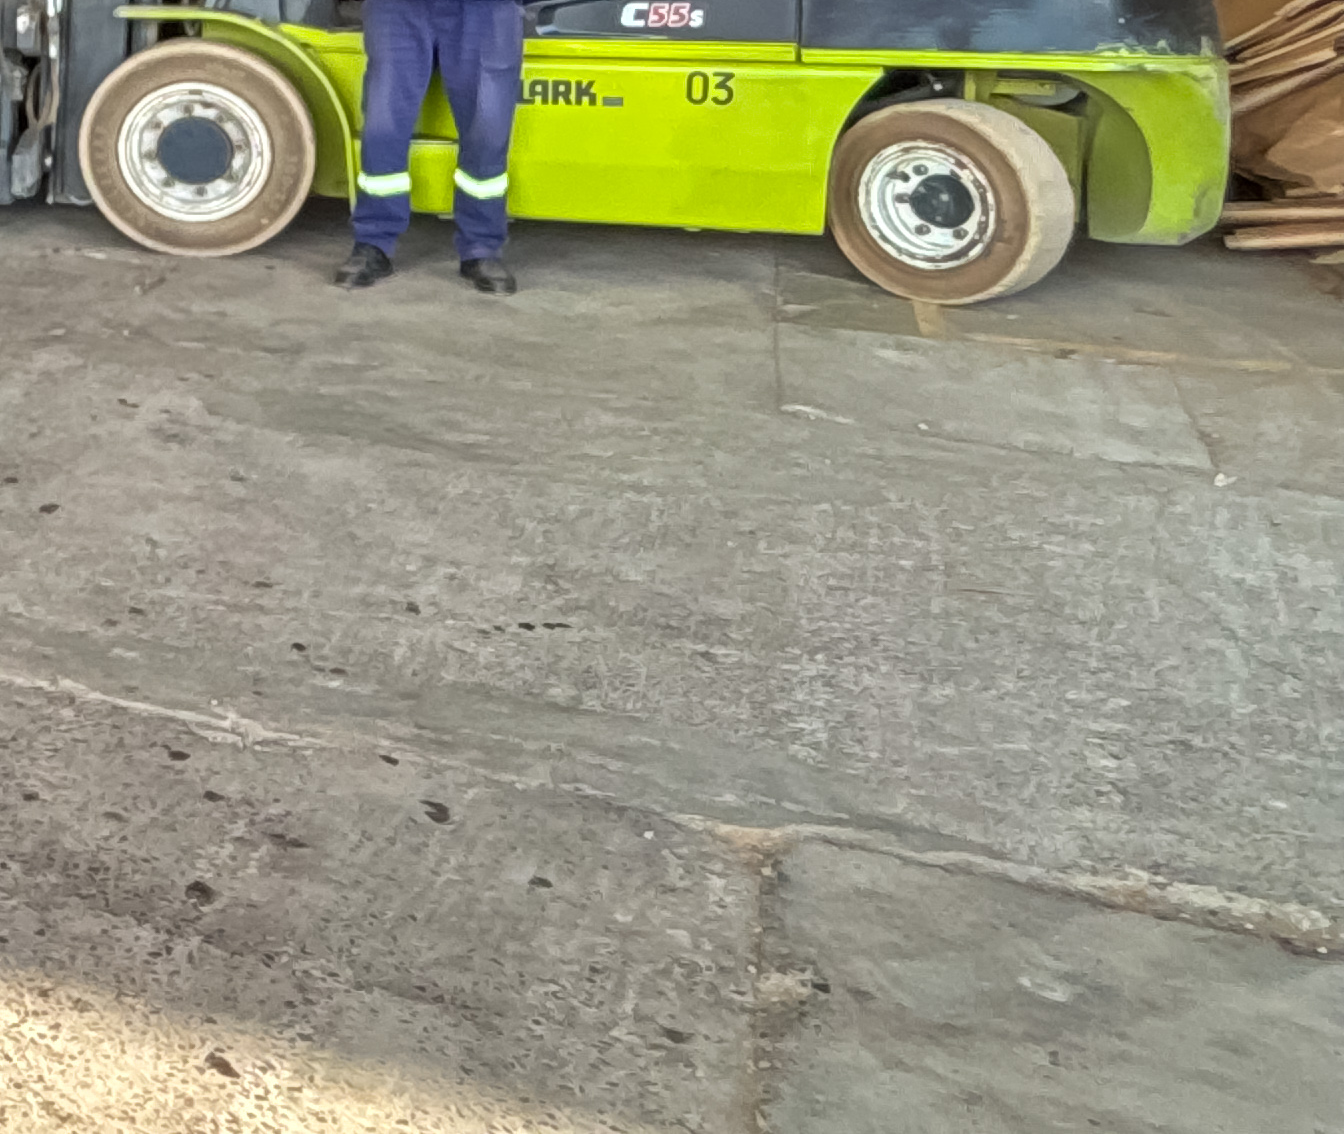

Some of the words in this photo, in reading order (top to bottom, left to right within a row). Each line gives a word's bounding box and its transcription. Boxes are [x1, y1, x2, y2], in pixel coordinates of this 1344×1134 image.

[621, 2, 704, 27] C55s
[516, 79, 597, 106] LARK
[686, 71, 735, 105] 03
